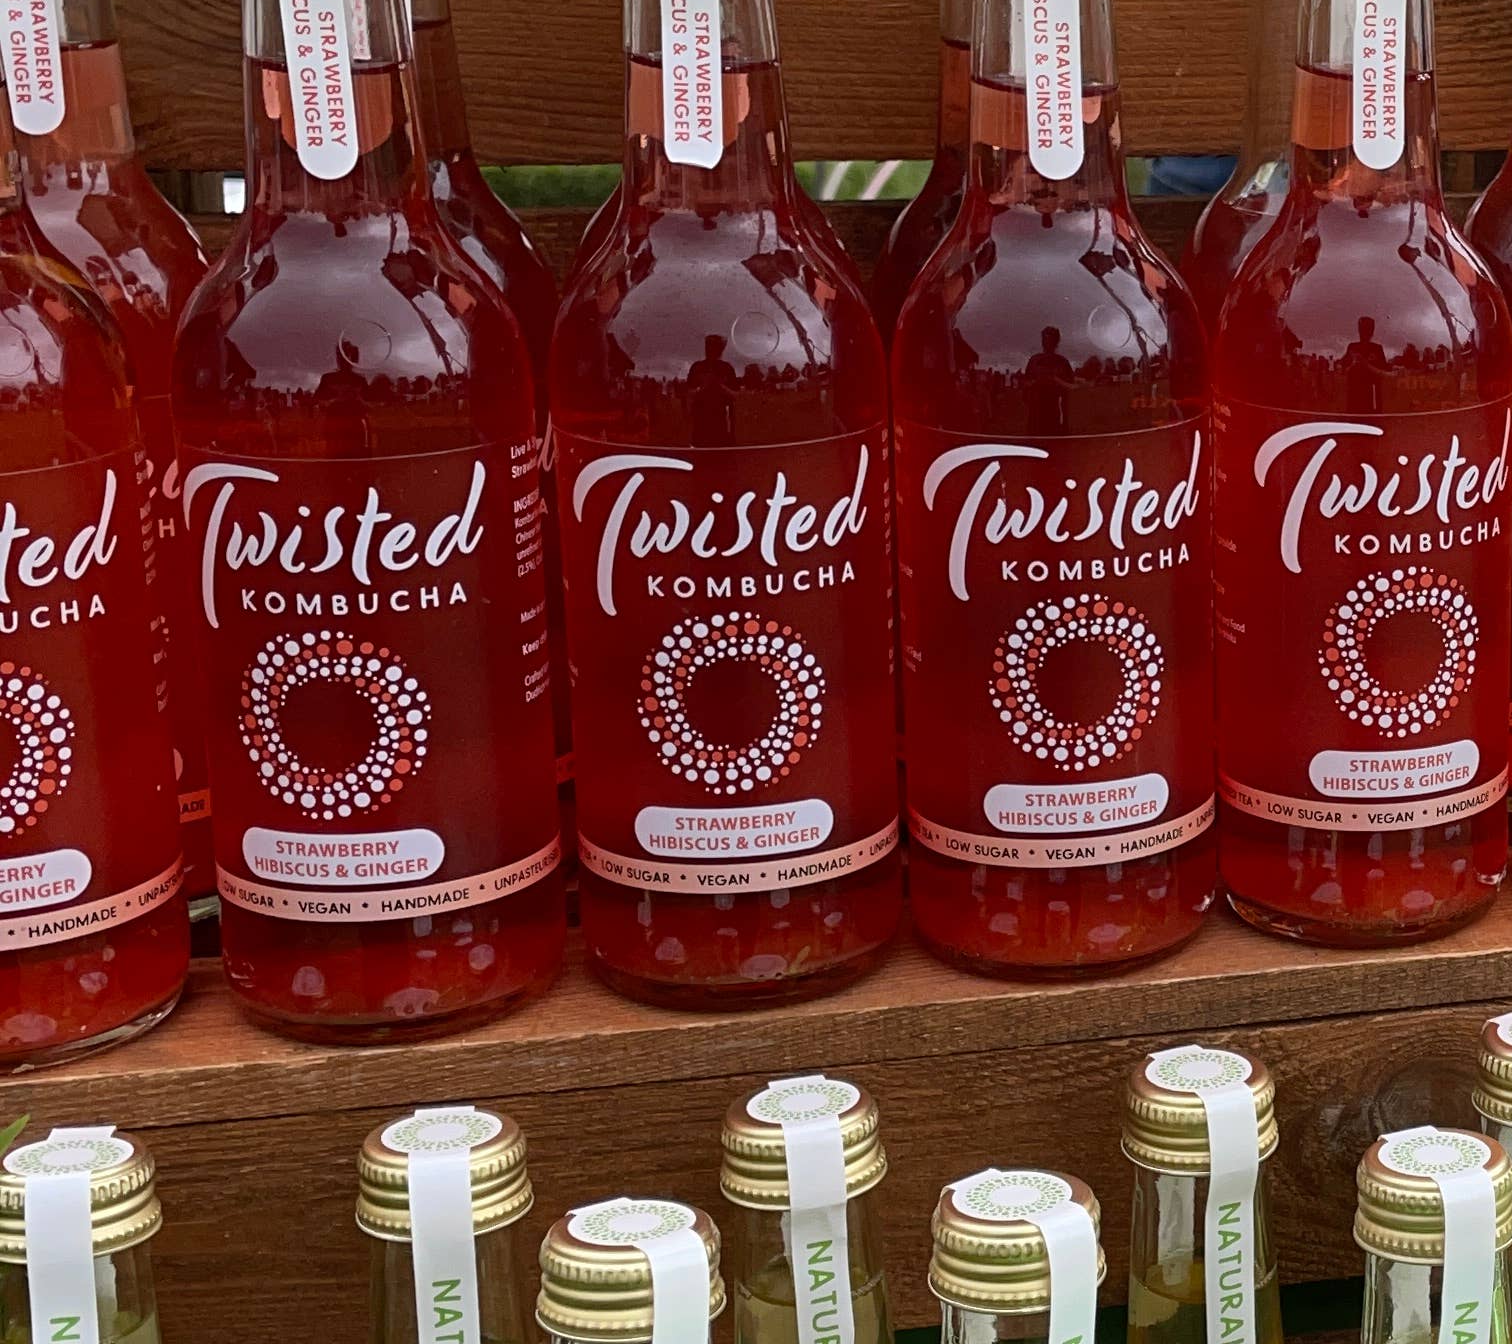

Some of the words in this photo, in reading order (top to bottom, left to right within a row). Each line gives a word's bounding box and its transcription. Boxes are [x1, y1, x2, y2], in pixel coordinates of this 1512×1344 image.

[299, 47, 313, 60] &
[1035, 54, 1048, 66] &
[1363, 46, 1376, 60] &
[318, 11, 348, 148] STRAWBERRY
[1055, 22, 1074, 151] STRAWBERRY
[1382, 17, 1397, 141] STRAWBERRY
[300, 67, 323, 148] GINGER
[1036, 73, 1053, 150] GINGER
[1361, 66, 1376, 141] GINGER
[1254, 408, 1511, 574] Twisted
[573, 444, 868, 616] Twisted
[923, 430, 1201, 601] Twisted
[183, 460, 486, 629] Twisted
[1335, 517, 1501, 556] KOMBUCHA
[1002, 542, 1190, 582] KOMBUCHA
[647, 565, 855, 598] KOMBUCHA
[241, 582, 468, 615] KOMBUCHA
[1349, 752, 1453, 773] STRAWBERRY
[1322, 774, 1401, 792] HIBISCUS
[1403, 776, 1416, 789] &
[1417, 767, 1471, 788] GINGER
[675, 810, 796, 831] STRAWBERRY
[275, 840, 400, 857] STRAWBERRY
[649, 831, 732, 850] HIBISCUS
[735, 834, 750, 848] &
[753, 826, 820, 848] GINGER
[254, 856, 330, 877] HIBISCUS
[336, 863, 349, 877] &
[354, 857, 429, 877] GINGER
[601, 859, 624, 876] LOW
[627, 864, 671, 883] SUGAR
[697, 873, 750, 887] VEGAN
[777, 855, 853, 881] HANDMADE
[238, 887, 274, 909] SUGAR
[298, 901, 351, 914] VEGAN
[381, 887, 470, 913] HANDMADE
